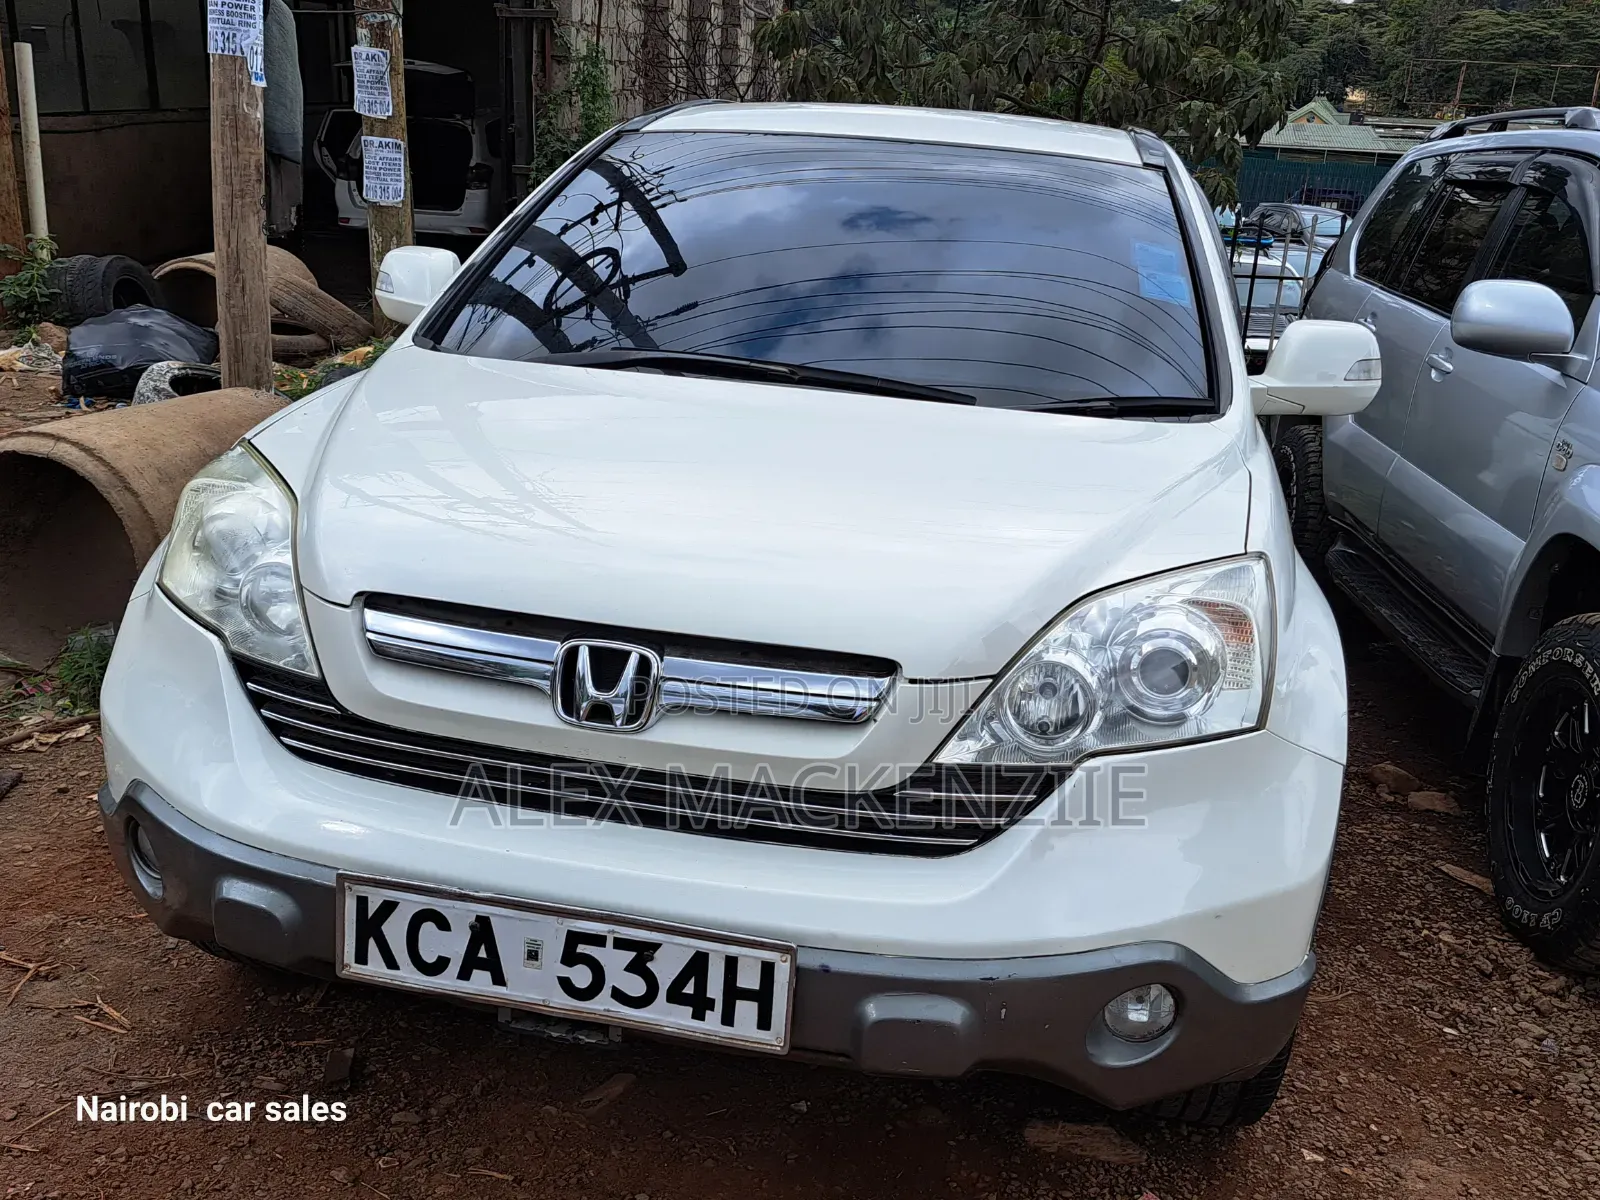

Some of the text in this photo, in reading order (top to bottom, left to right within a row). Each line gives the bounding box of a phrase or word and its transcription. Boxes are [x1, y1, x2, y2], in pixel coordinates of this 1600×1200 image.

[221, 1, 256, 12] POWER
[226, 10, 257, 20] BOOSTING
[238, 20, 257, 29] RING
[220, 31, 237, 55] 315
[378, 185, 390, 200] 315
[354, 894, 776, 1031] KCA 534H
